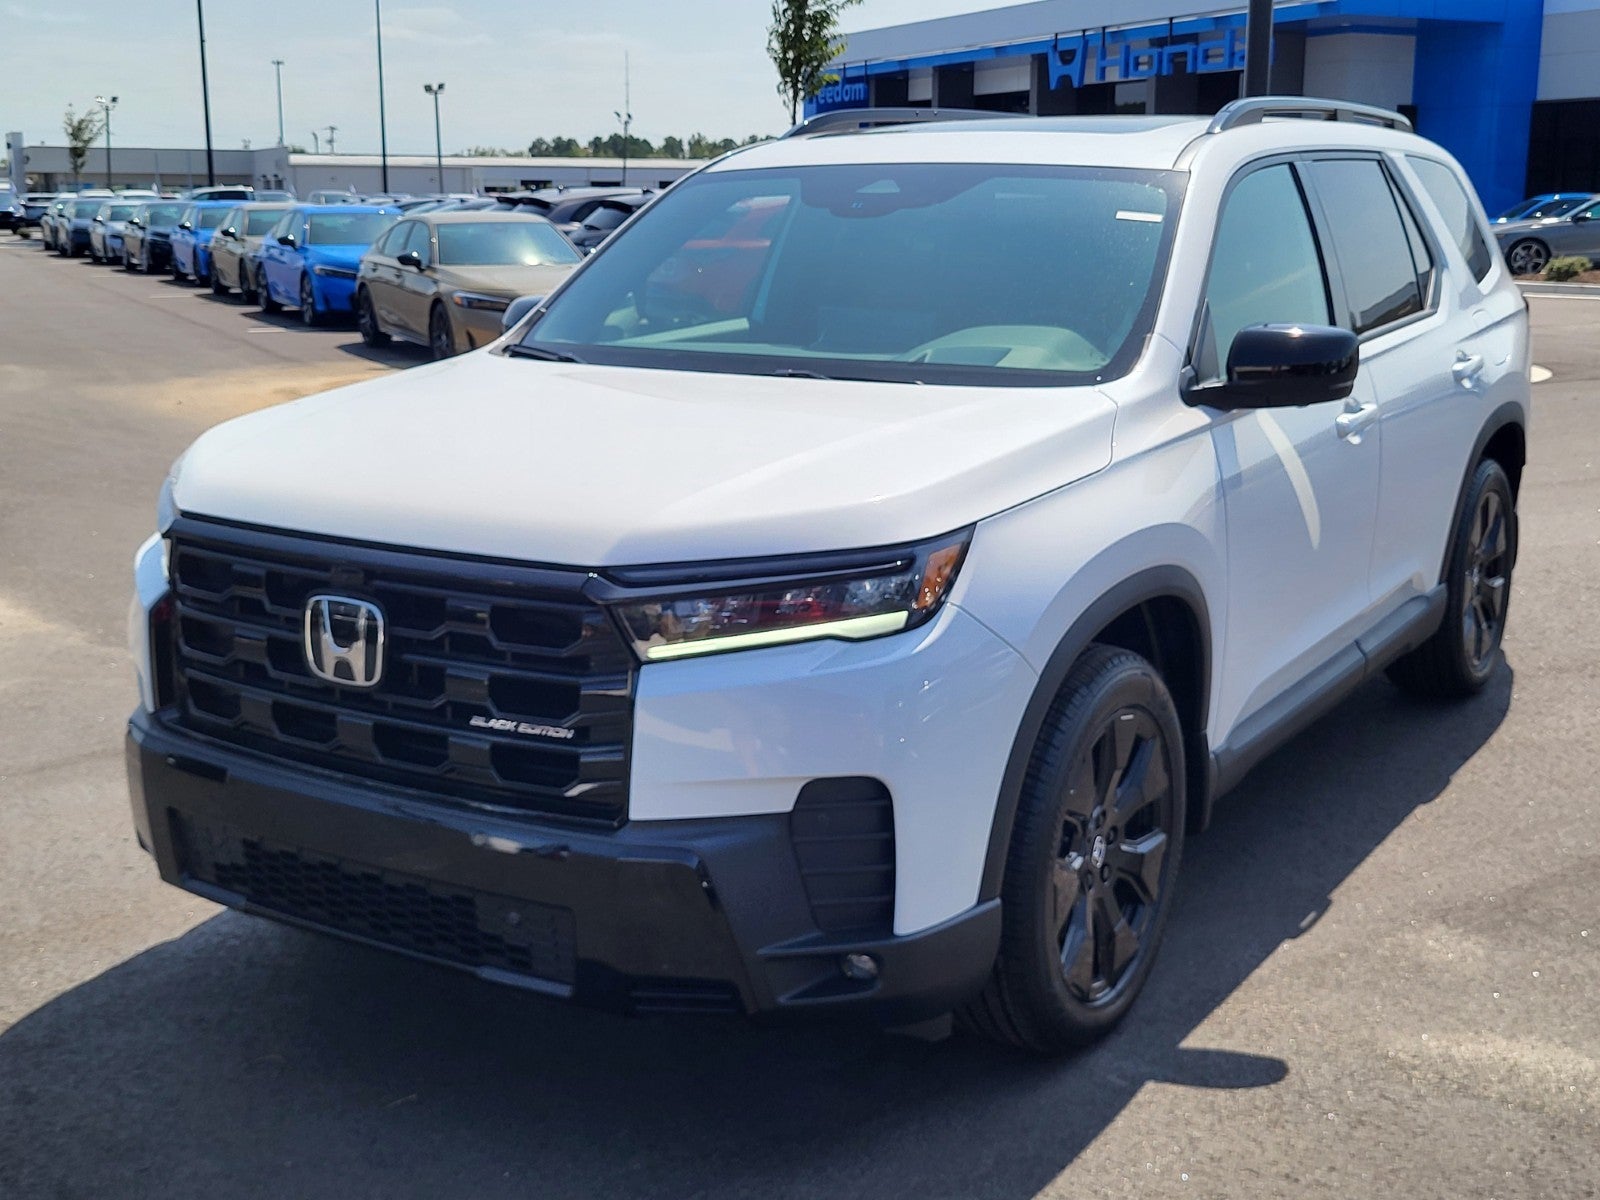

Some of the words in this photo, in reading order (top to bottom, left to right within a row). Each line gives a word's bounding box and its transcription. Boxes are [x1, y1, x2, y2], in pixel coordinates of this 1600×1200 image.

[812, 80, 864, 104] eedom
[469, 715, 517, 732] BLACK
[518, 723, 575, 739] EDITION
